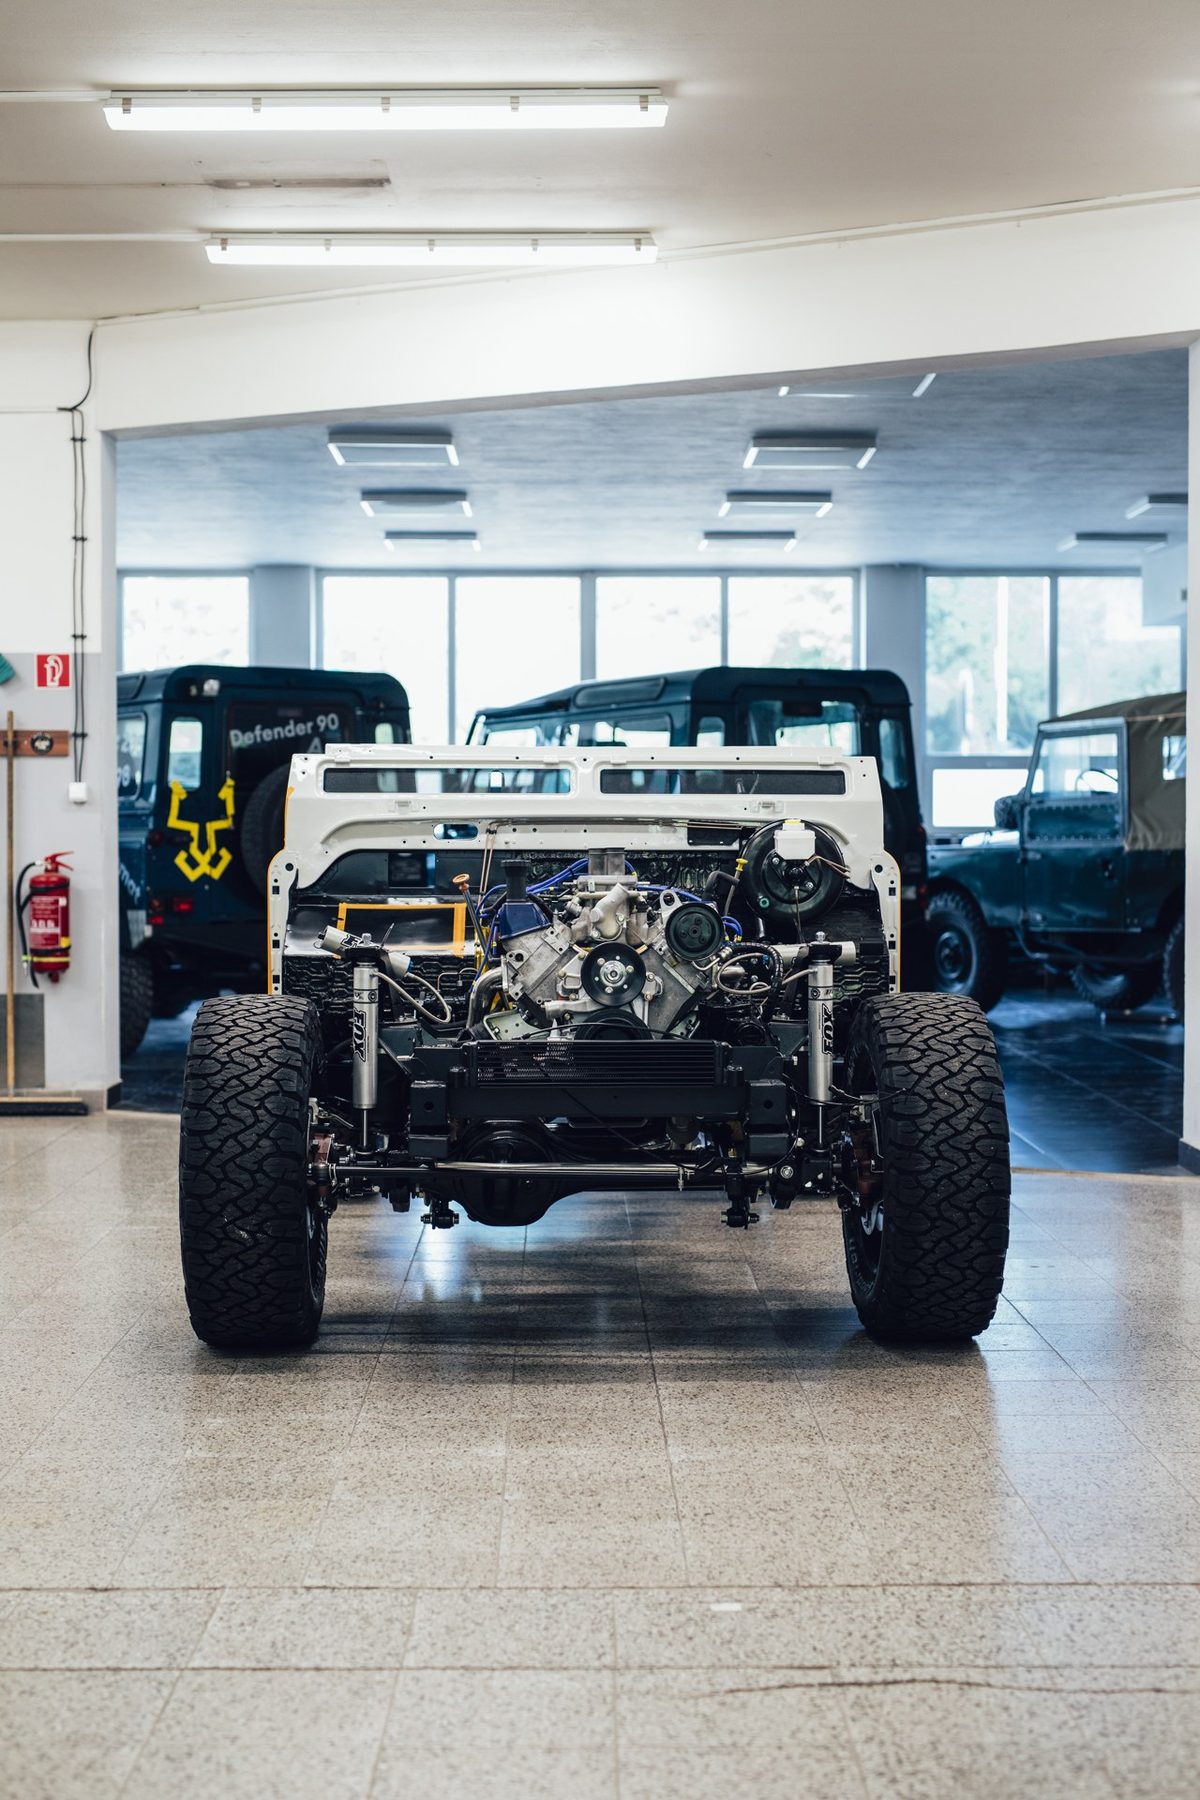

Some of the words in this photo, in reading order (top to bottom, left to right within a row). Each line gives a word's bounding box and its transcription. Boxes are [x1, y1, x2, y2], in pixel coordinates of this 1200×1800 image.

[229, 719, 314, 749] Defender
[316, 713, 340, 732] 90
[353, 1008, 366, 1061] FOX
[822, 1003, 834, 1055] FOX
